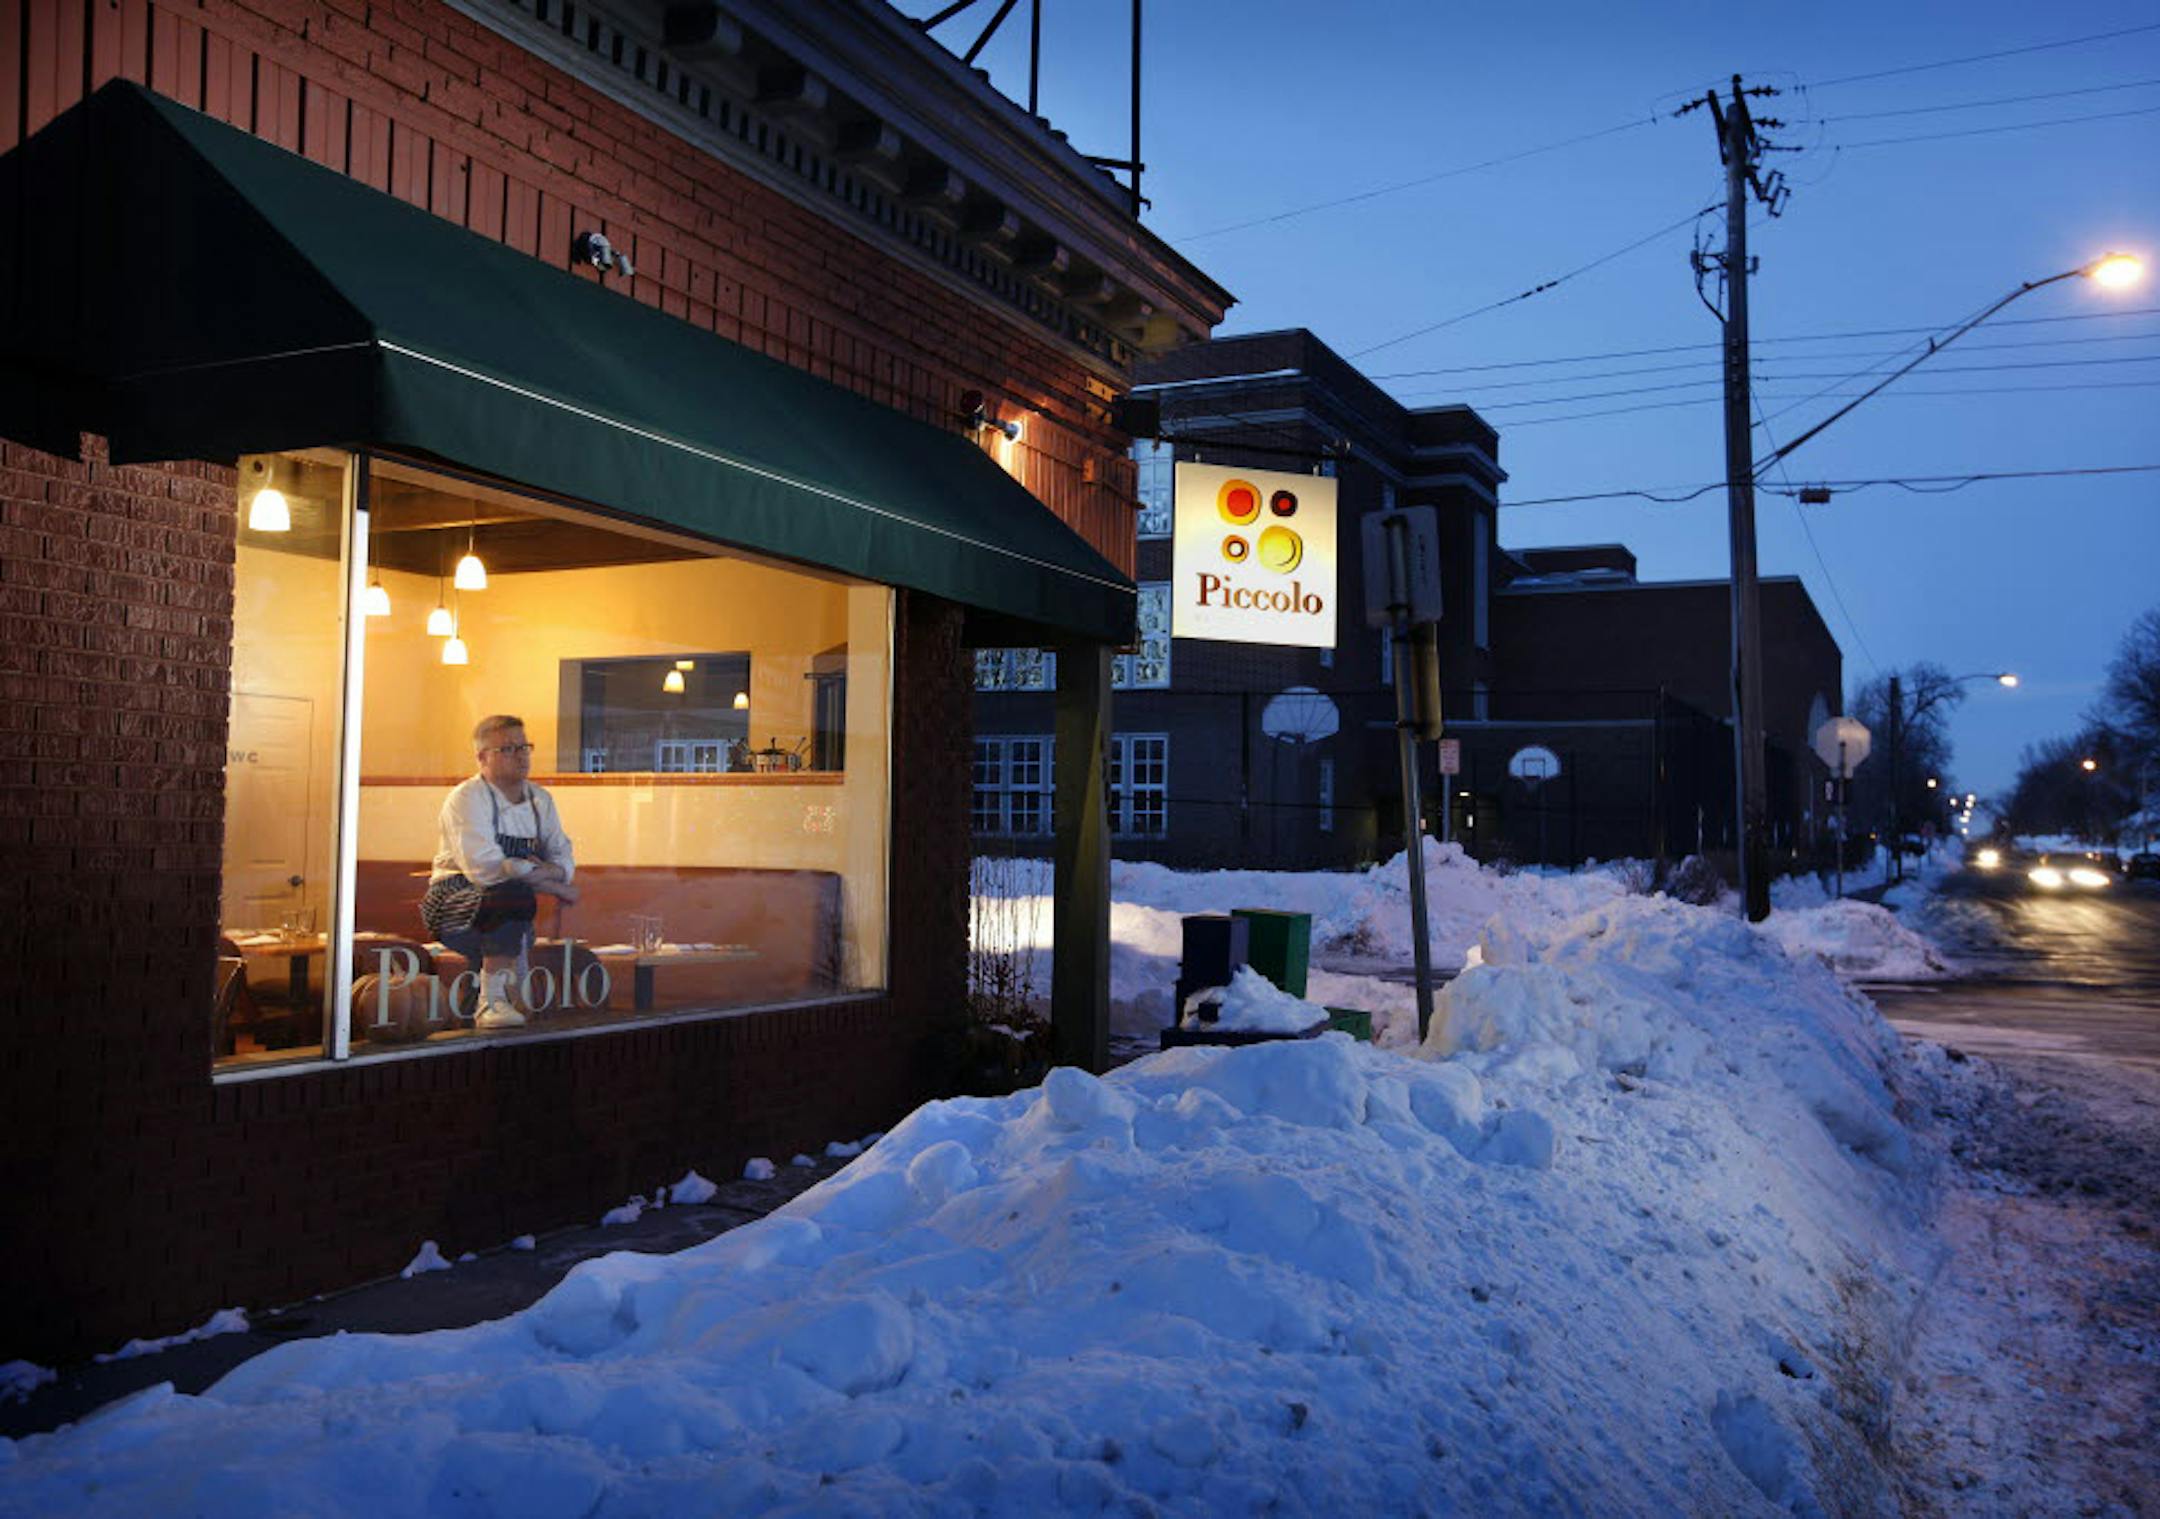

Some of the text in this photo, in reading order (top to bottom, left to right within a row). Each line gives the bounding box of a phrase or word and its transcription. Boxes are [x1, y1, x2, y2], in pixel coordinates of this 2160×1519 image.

[1196, 572, 1323, 615] Piccolo
[230, 750, 259, 763] WC
[369, 938, 611, 1028] Piccolo
